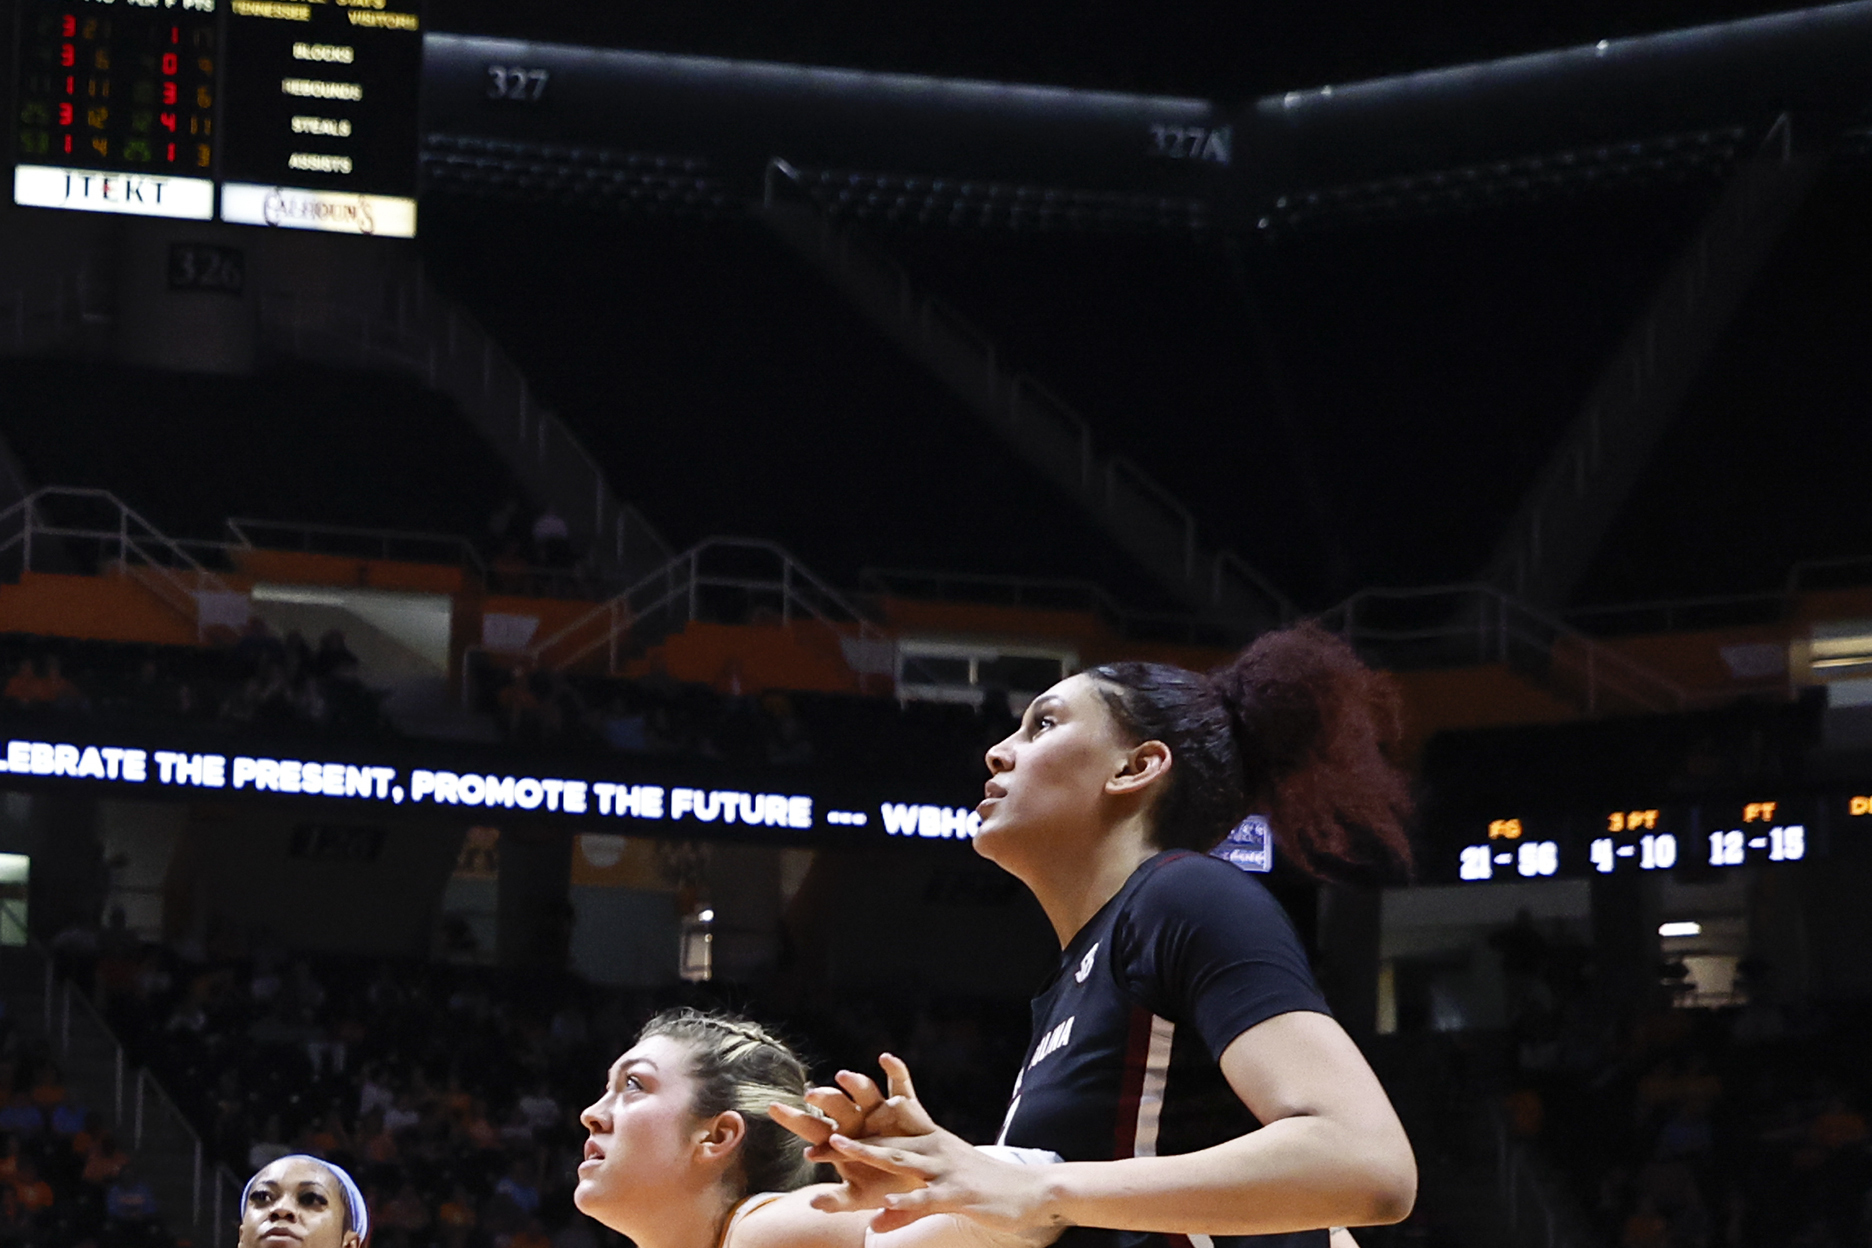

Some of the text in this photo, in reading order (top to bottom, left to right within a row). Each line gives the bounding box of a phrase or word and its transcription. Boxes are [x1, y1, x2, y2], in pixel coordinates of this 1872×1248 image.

[487, 65, 549, 101] 327
[60, 173, 169, 207] JTEKT
[154, 751, 226, 787] THE
[232, 757, 405, 804] PRESENT,
[410, 769, 588, 813] PROMOTE
[592, 782, 665, 819] THE
[670, 788, 813, 829] FUTURE
